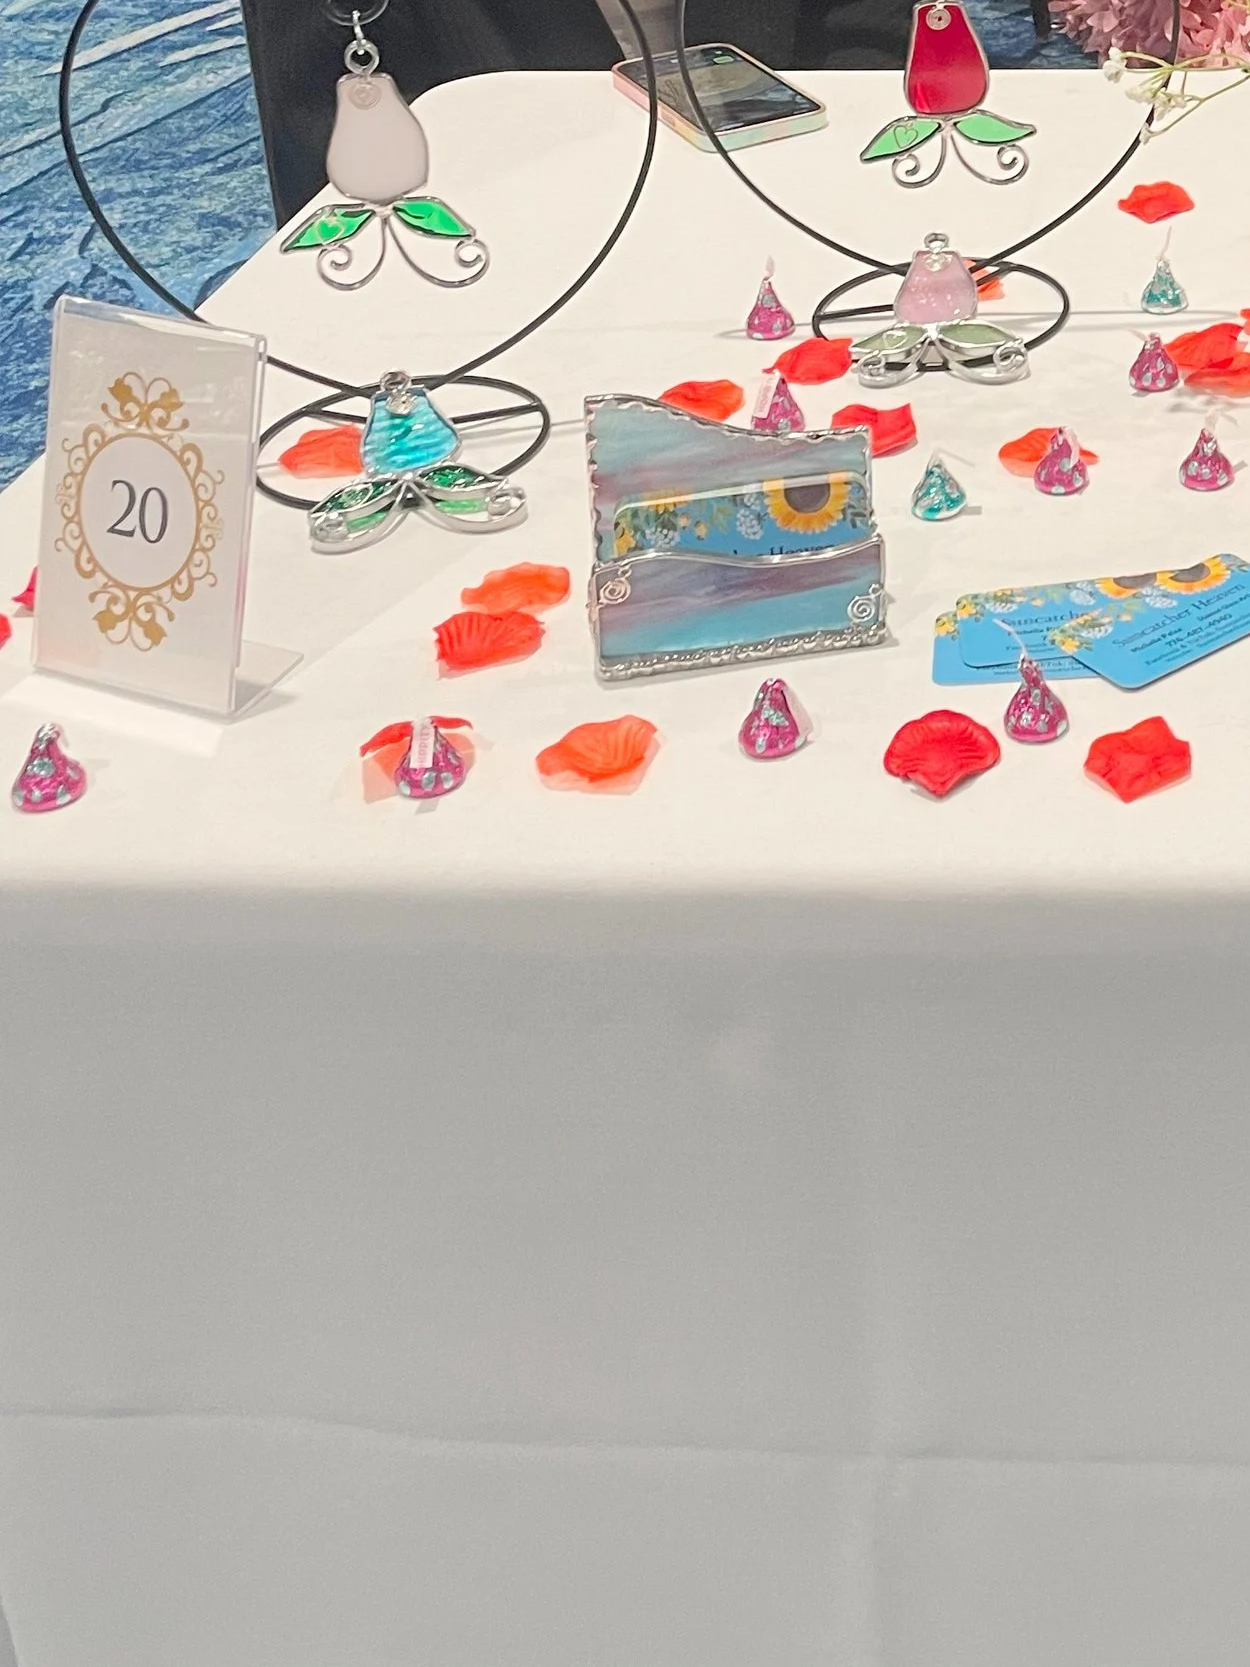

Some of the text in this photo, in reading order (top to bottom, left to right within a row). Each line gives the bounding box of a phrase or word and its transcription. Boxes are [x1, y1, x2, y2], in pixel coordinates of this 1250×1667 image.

[106, 479, 168, 544] 20
[1112, 607, 1192, 648] Suncatcher
[1191, 583, 1246, 612] Heaven
